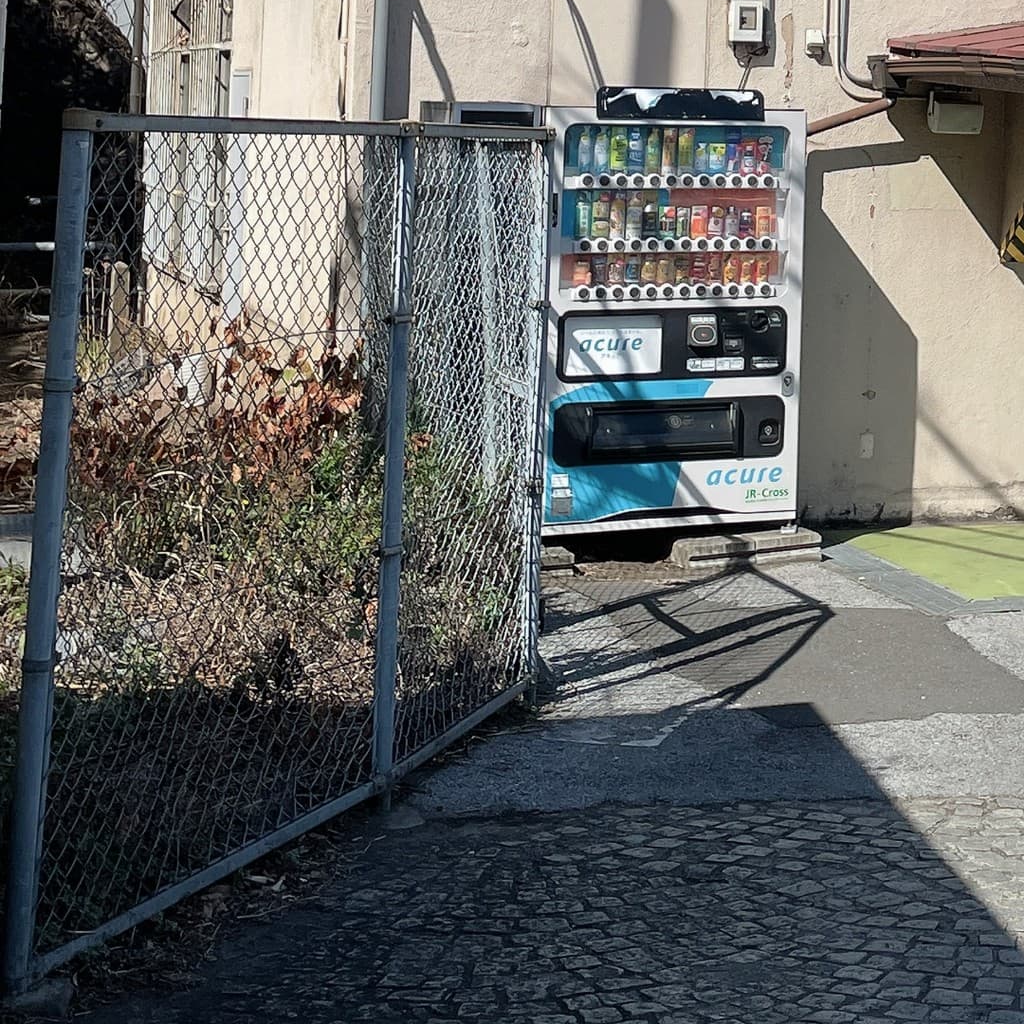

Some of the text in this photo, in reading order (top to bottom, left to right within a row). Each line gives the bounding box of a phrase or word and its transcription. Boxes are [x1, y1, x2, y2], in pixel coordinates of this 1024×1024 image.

[579, 336, 643, 353] acure
[706, 466, 783, 486] acure
[745, 487, 789, 499] JR-Cross
